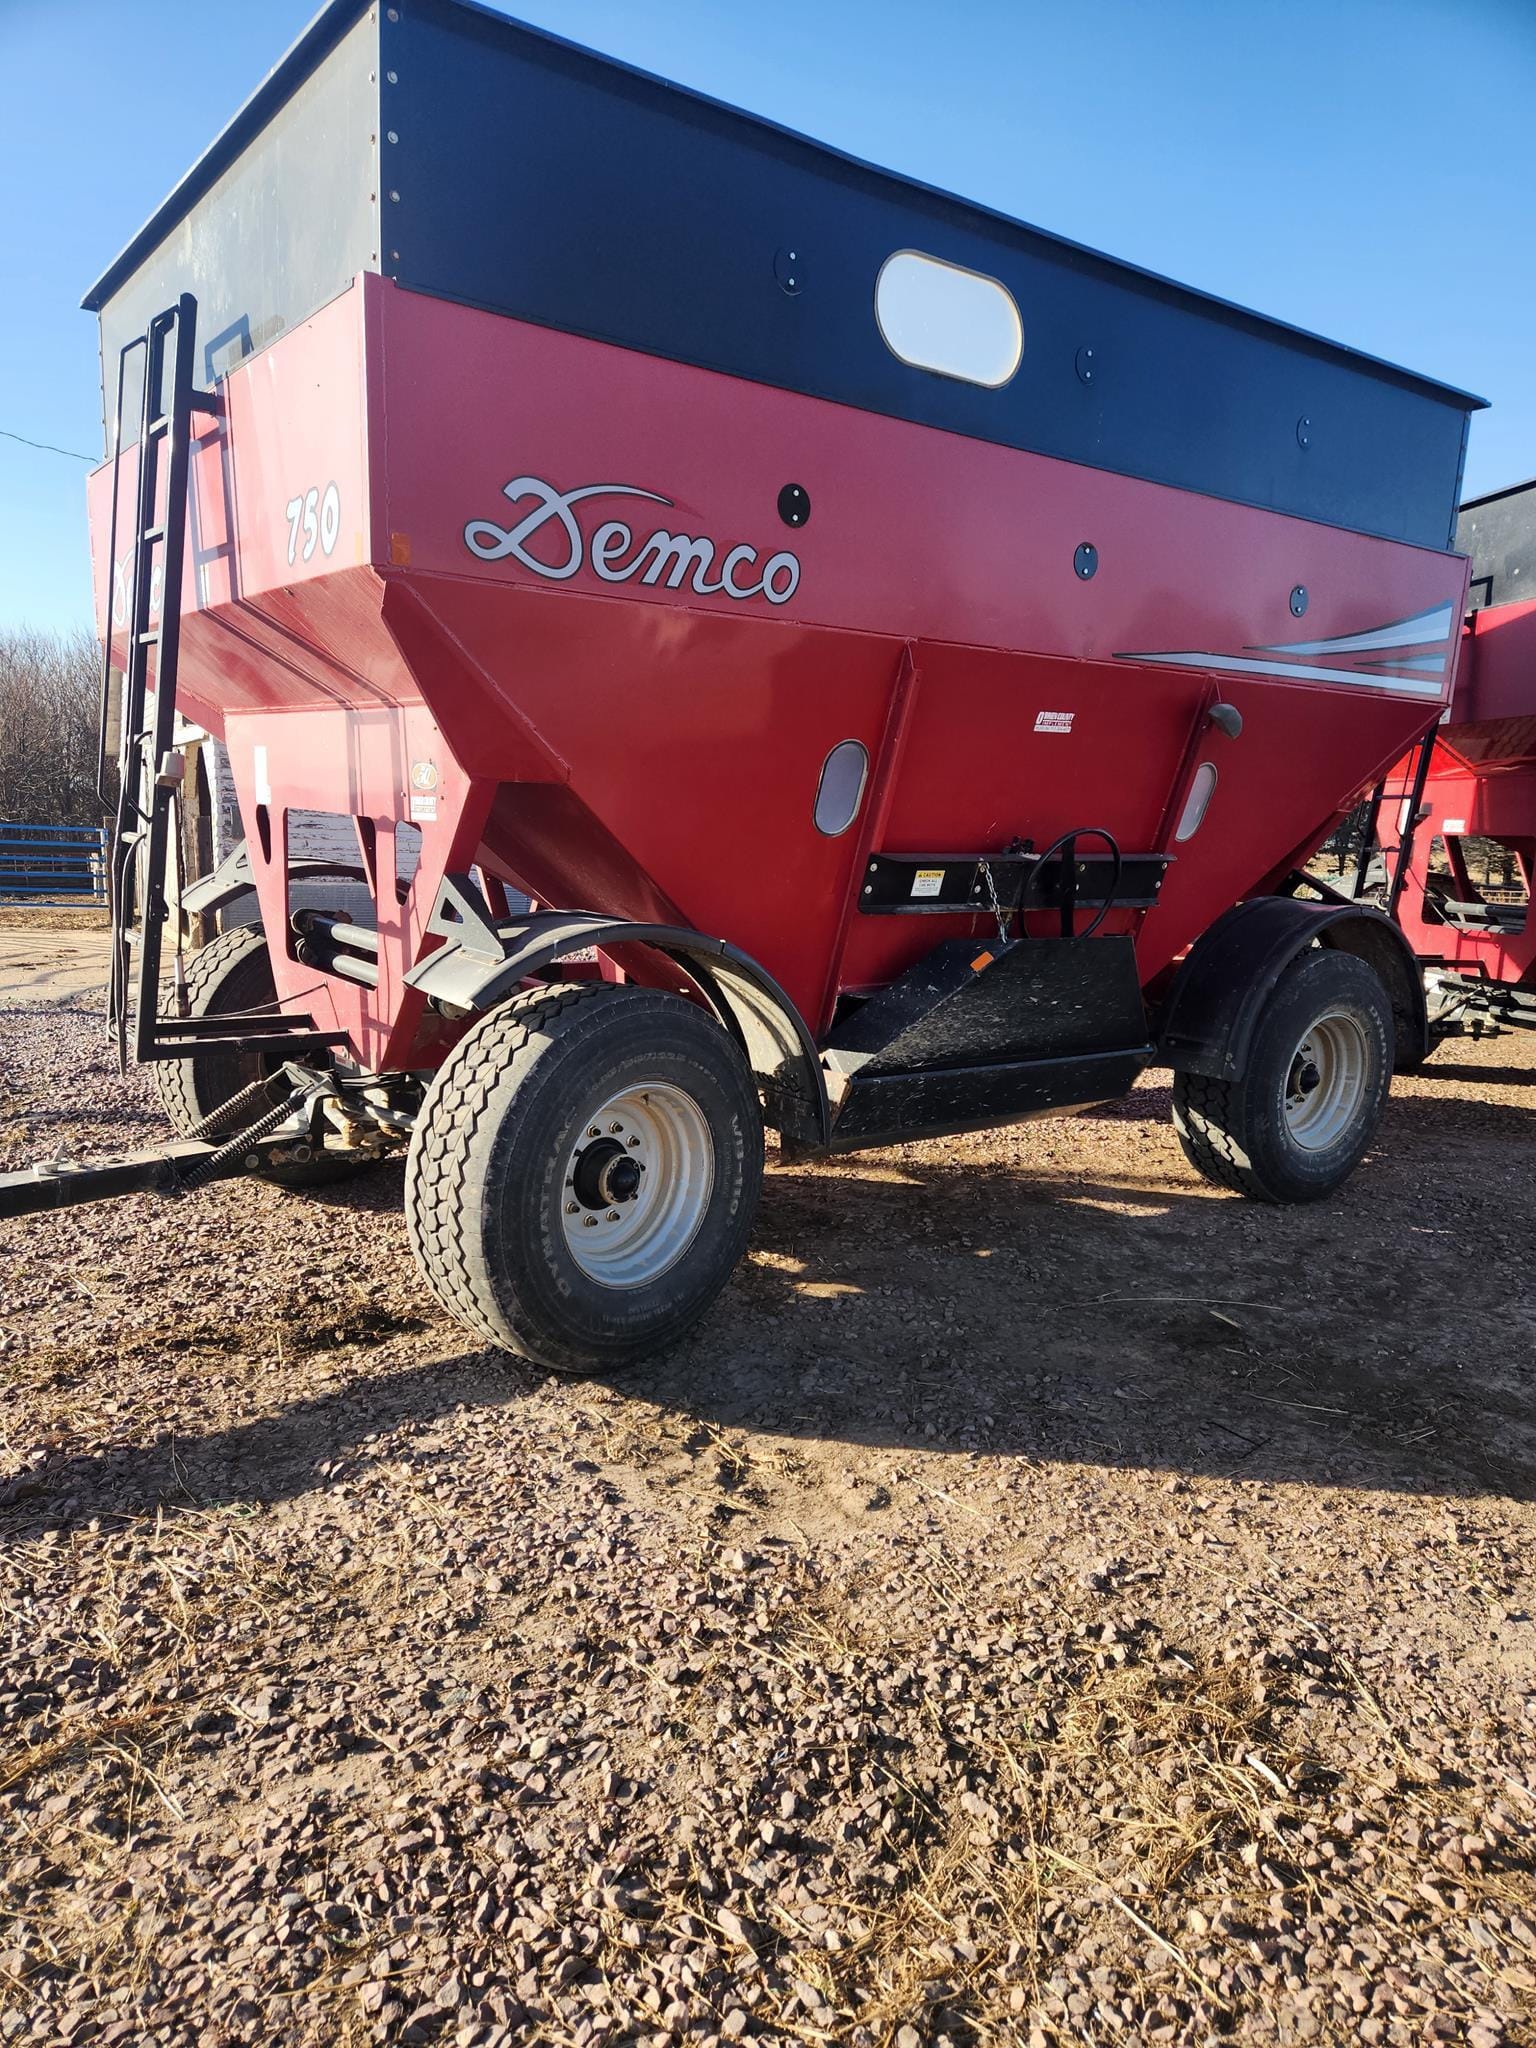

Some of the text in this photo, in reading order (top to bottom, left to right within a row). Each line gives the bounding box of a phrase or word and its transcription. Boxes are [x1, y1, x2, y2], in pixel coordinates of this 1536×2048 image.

[286, 480, 341, 567] 750
[464, 476, 802, 605] Demco
[541, 1107, 579, 1298] DYNATRAC
